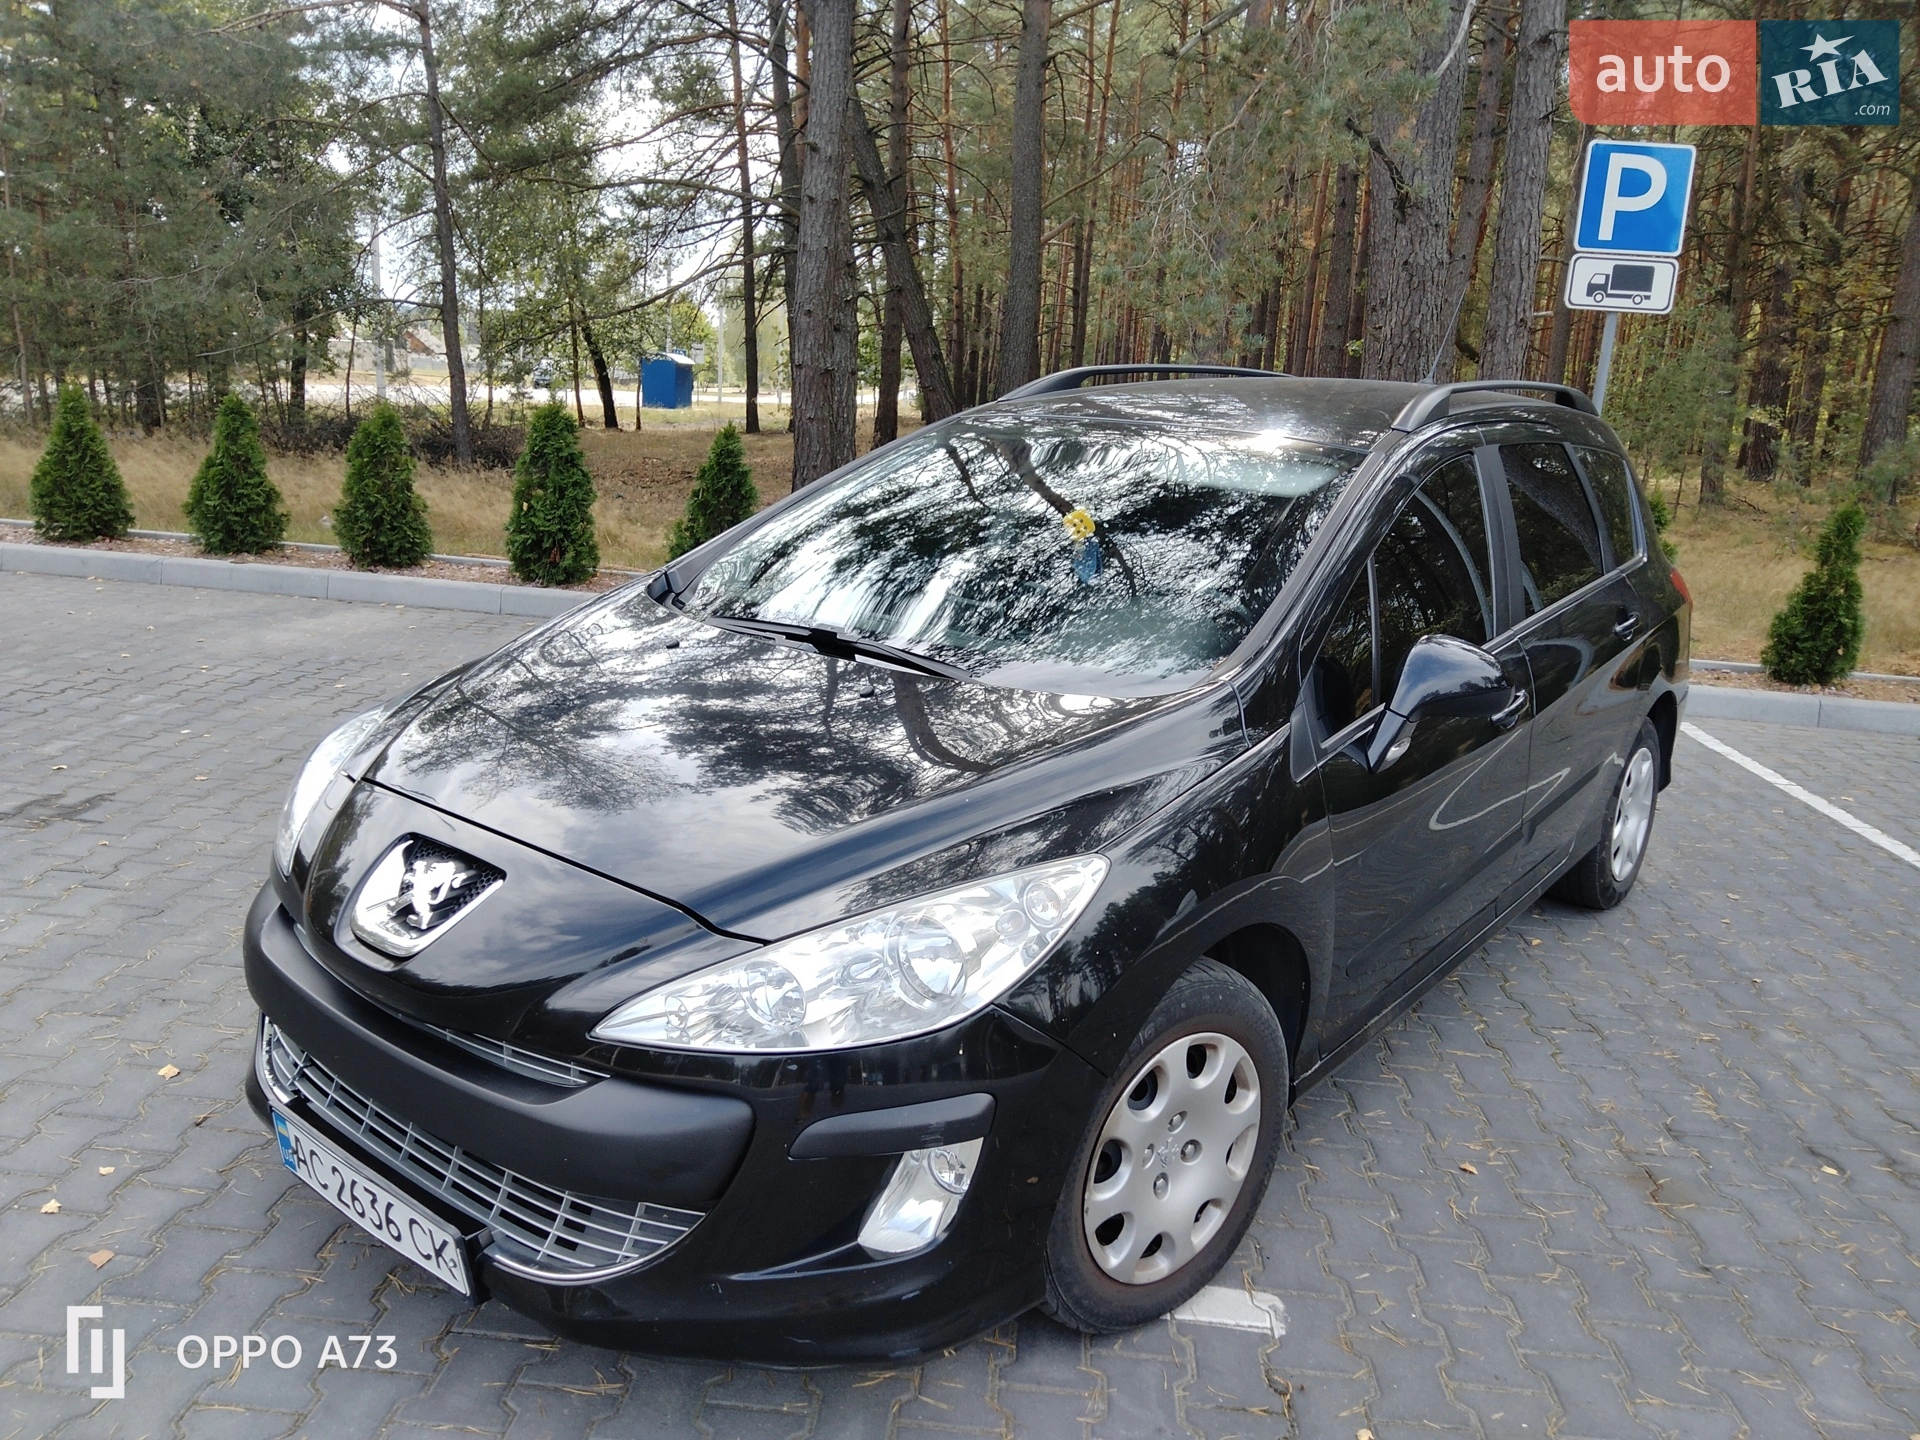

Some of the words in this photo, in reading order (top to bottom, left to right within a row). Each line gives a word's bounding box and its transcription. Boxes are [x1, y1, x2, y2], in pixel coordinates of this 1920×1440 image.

[1598, 153, 1667, 241] P
[294, 1133, 329, 1190] AC
[331, 1165, 402, 1242] 2636
[408, 1217, 459, 1281] CK
